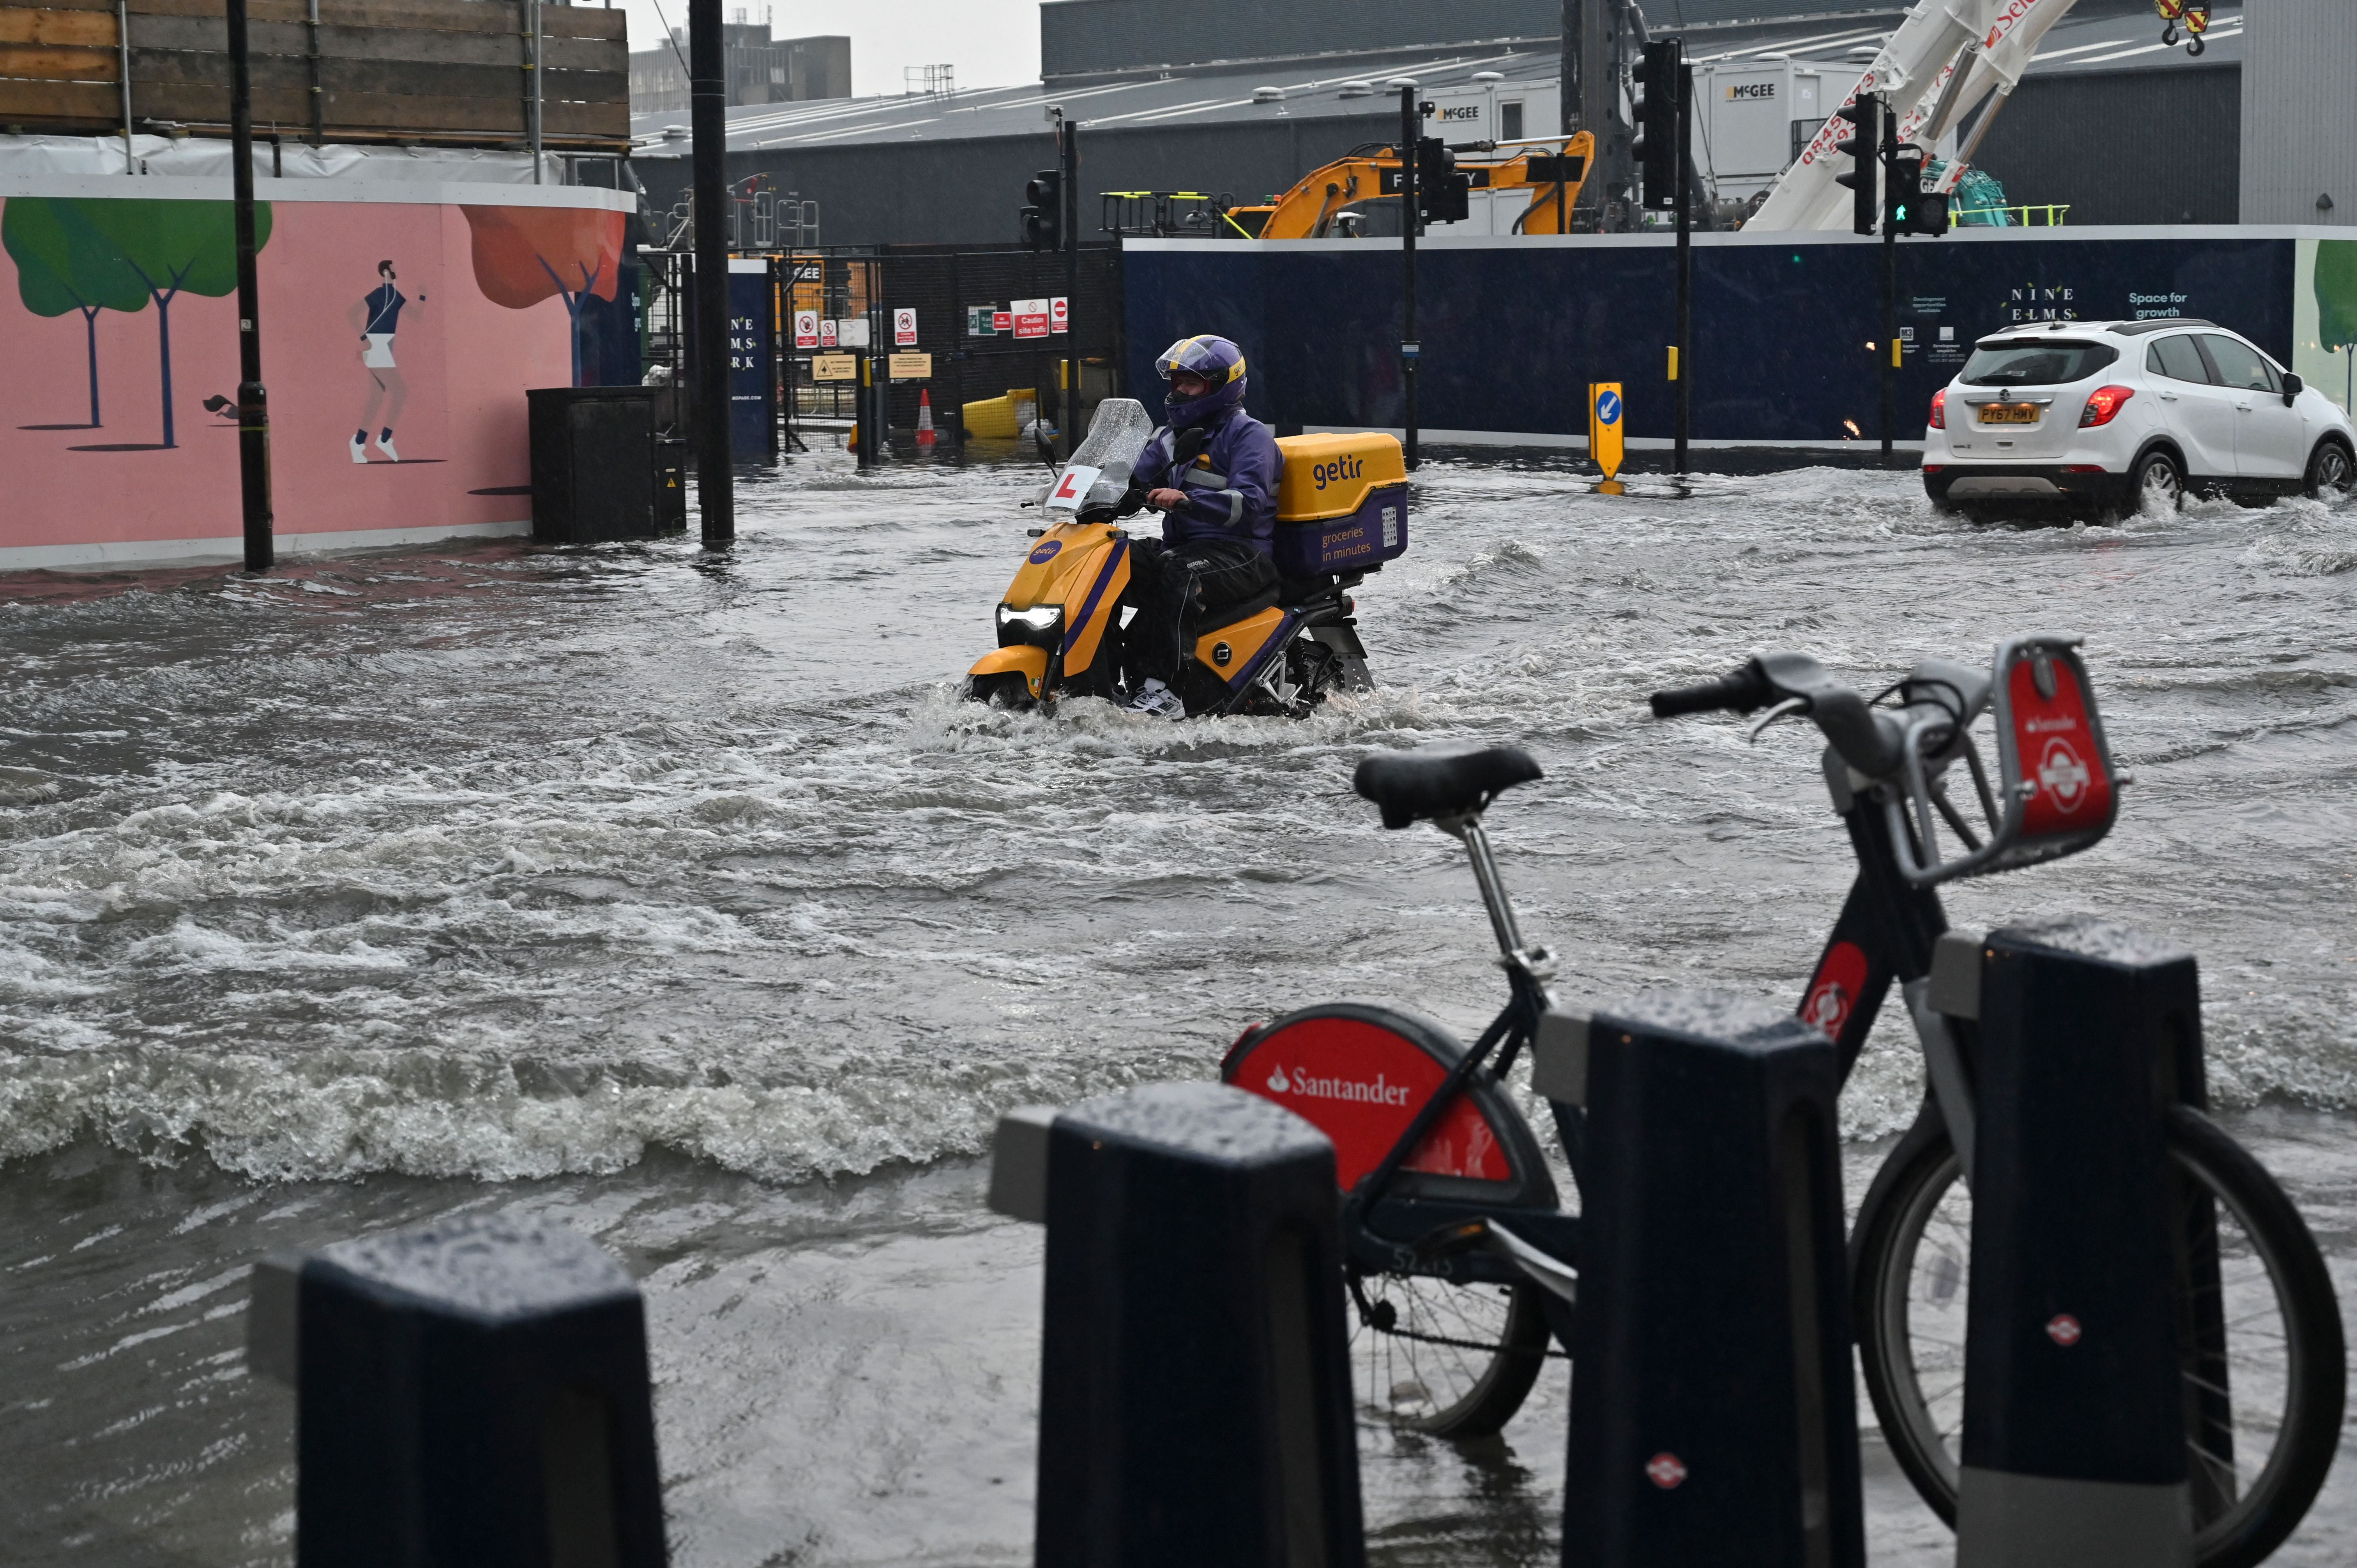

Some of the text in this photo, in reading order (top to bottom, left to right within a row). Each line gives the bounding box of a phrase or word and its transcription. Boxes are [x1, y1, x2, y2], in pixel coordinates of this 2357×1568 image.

[2011, 289, 2073, 300] NINE
[2129, 292, 2187, 305] Space for
[2012, 308, 2073, 320] ELMS
[2136, 307, 2180, 320] growth
[1901, 329, 1912, 337] M3
[1981, 409, 2009, 420] PY67
[1313, 454, 1363, 490] getir
[1055, 473, 1077, 499] L
[1322, 527, 1364, 548] groceries
[1033, 547, 1056, 556] getir
[1323, 542, 1371, 562] in minutes
[1292, 1067, 1410, 1105] Santander
